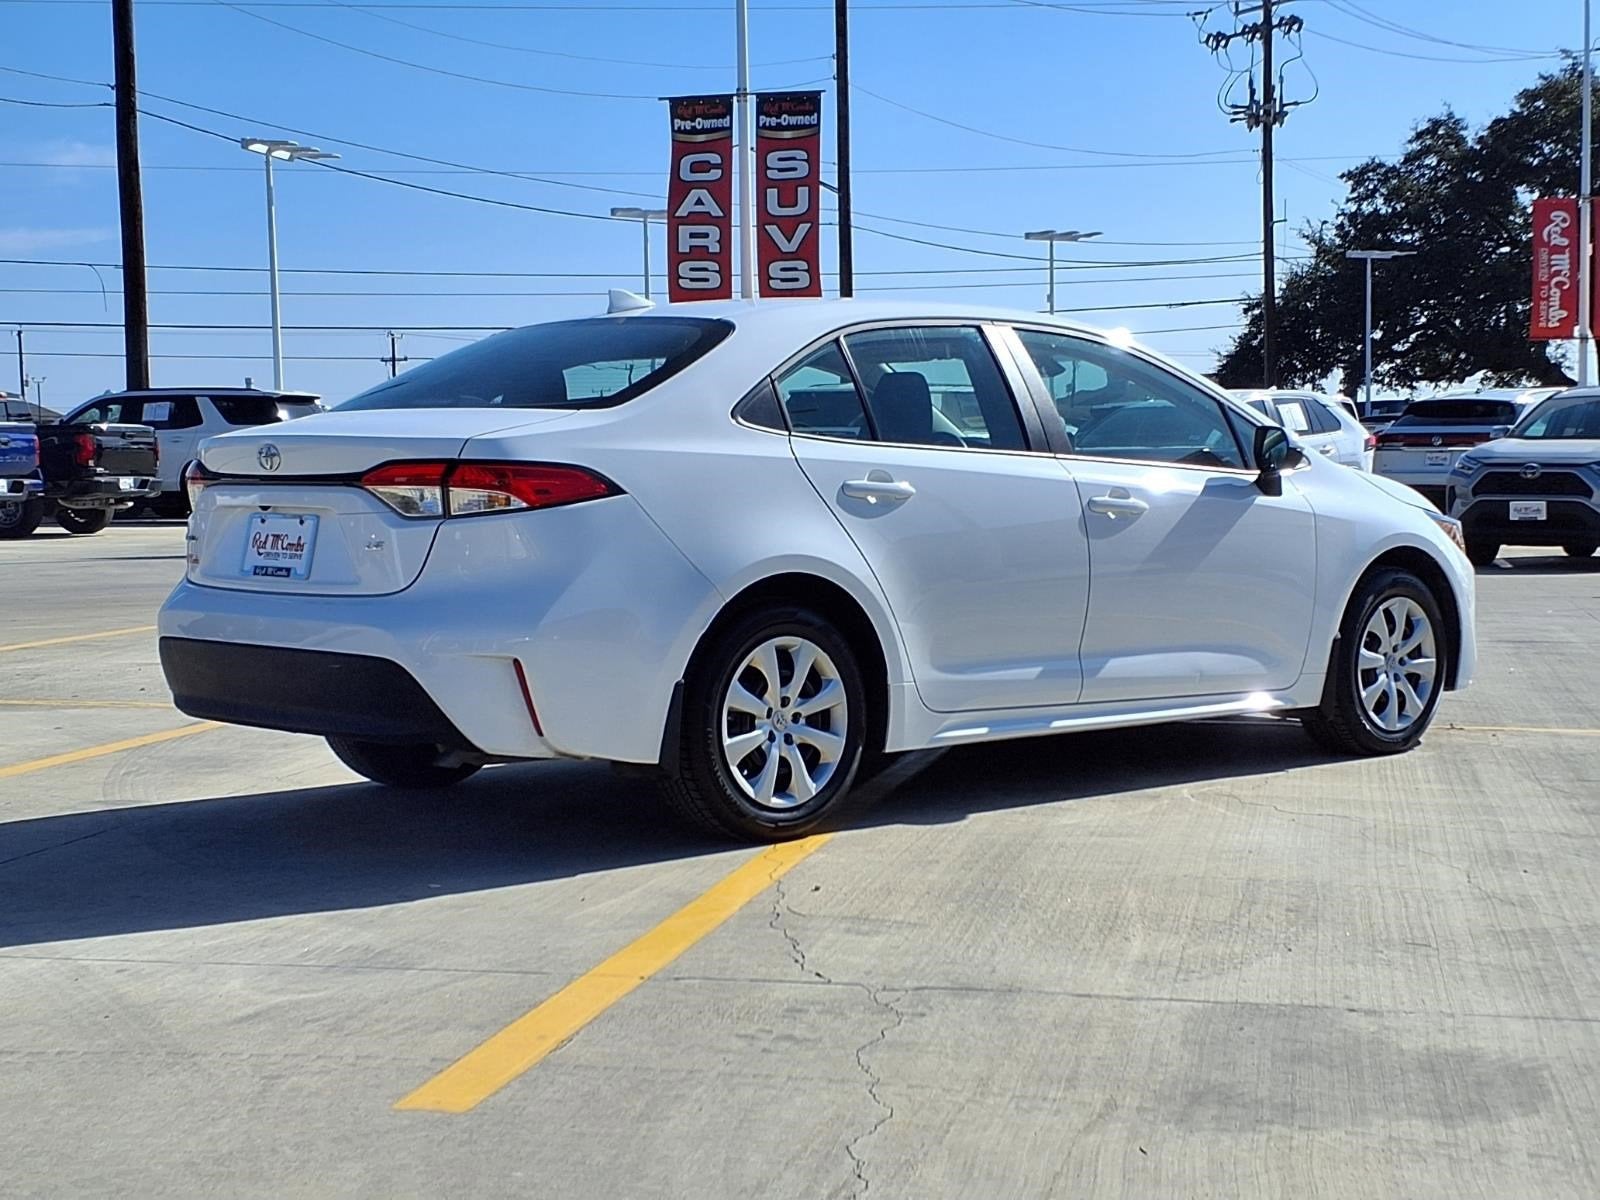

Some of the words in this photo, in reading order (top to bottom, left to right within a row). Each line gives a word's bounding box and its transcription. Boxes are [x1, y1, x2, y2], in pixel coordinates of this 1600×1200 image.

[673, 115, 731, 131] Pre-Owned
[758, 113, 818, 127] Pre-Owned
[673, 152, 725, 290] CARS
[764, 149, 813, 291] SUVS
[1542, 210, 1571, 247] Red
[1538, 301, 1548, 328] SERVE
[252, 531, 269, 556] Red
